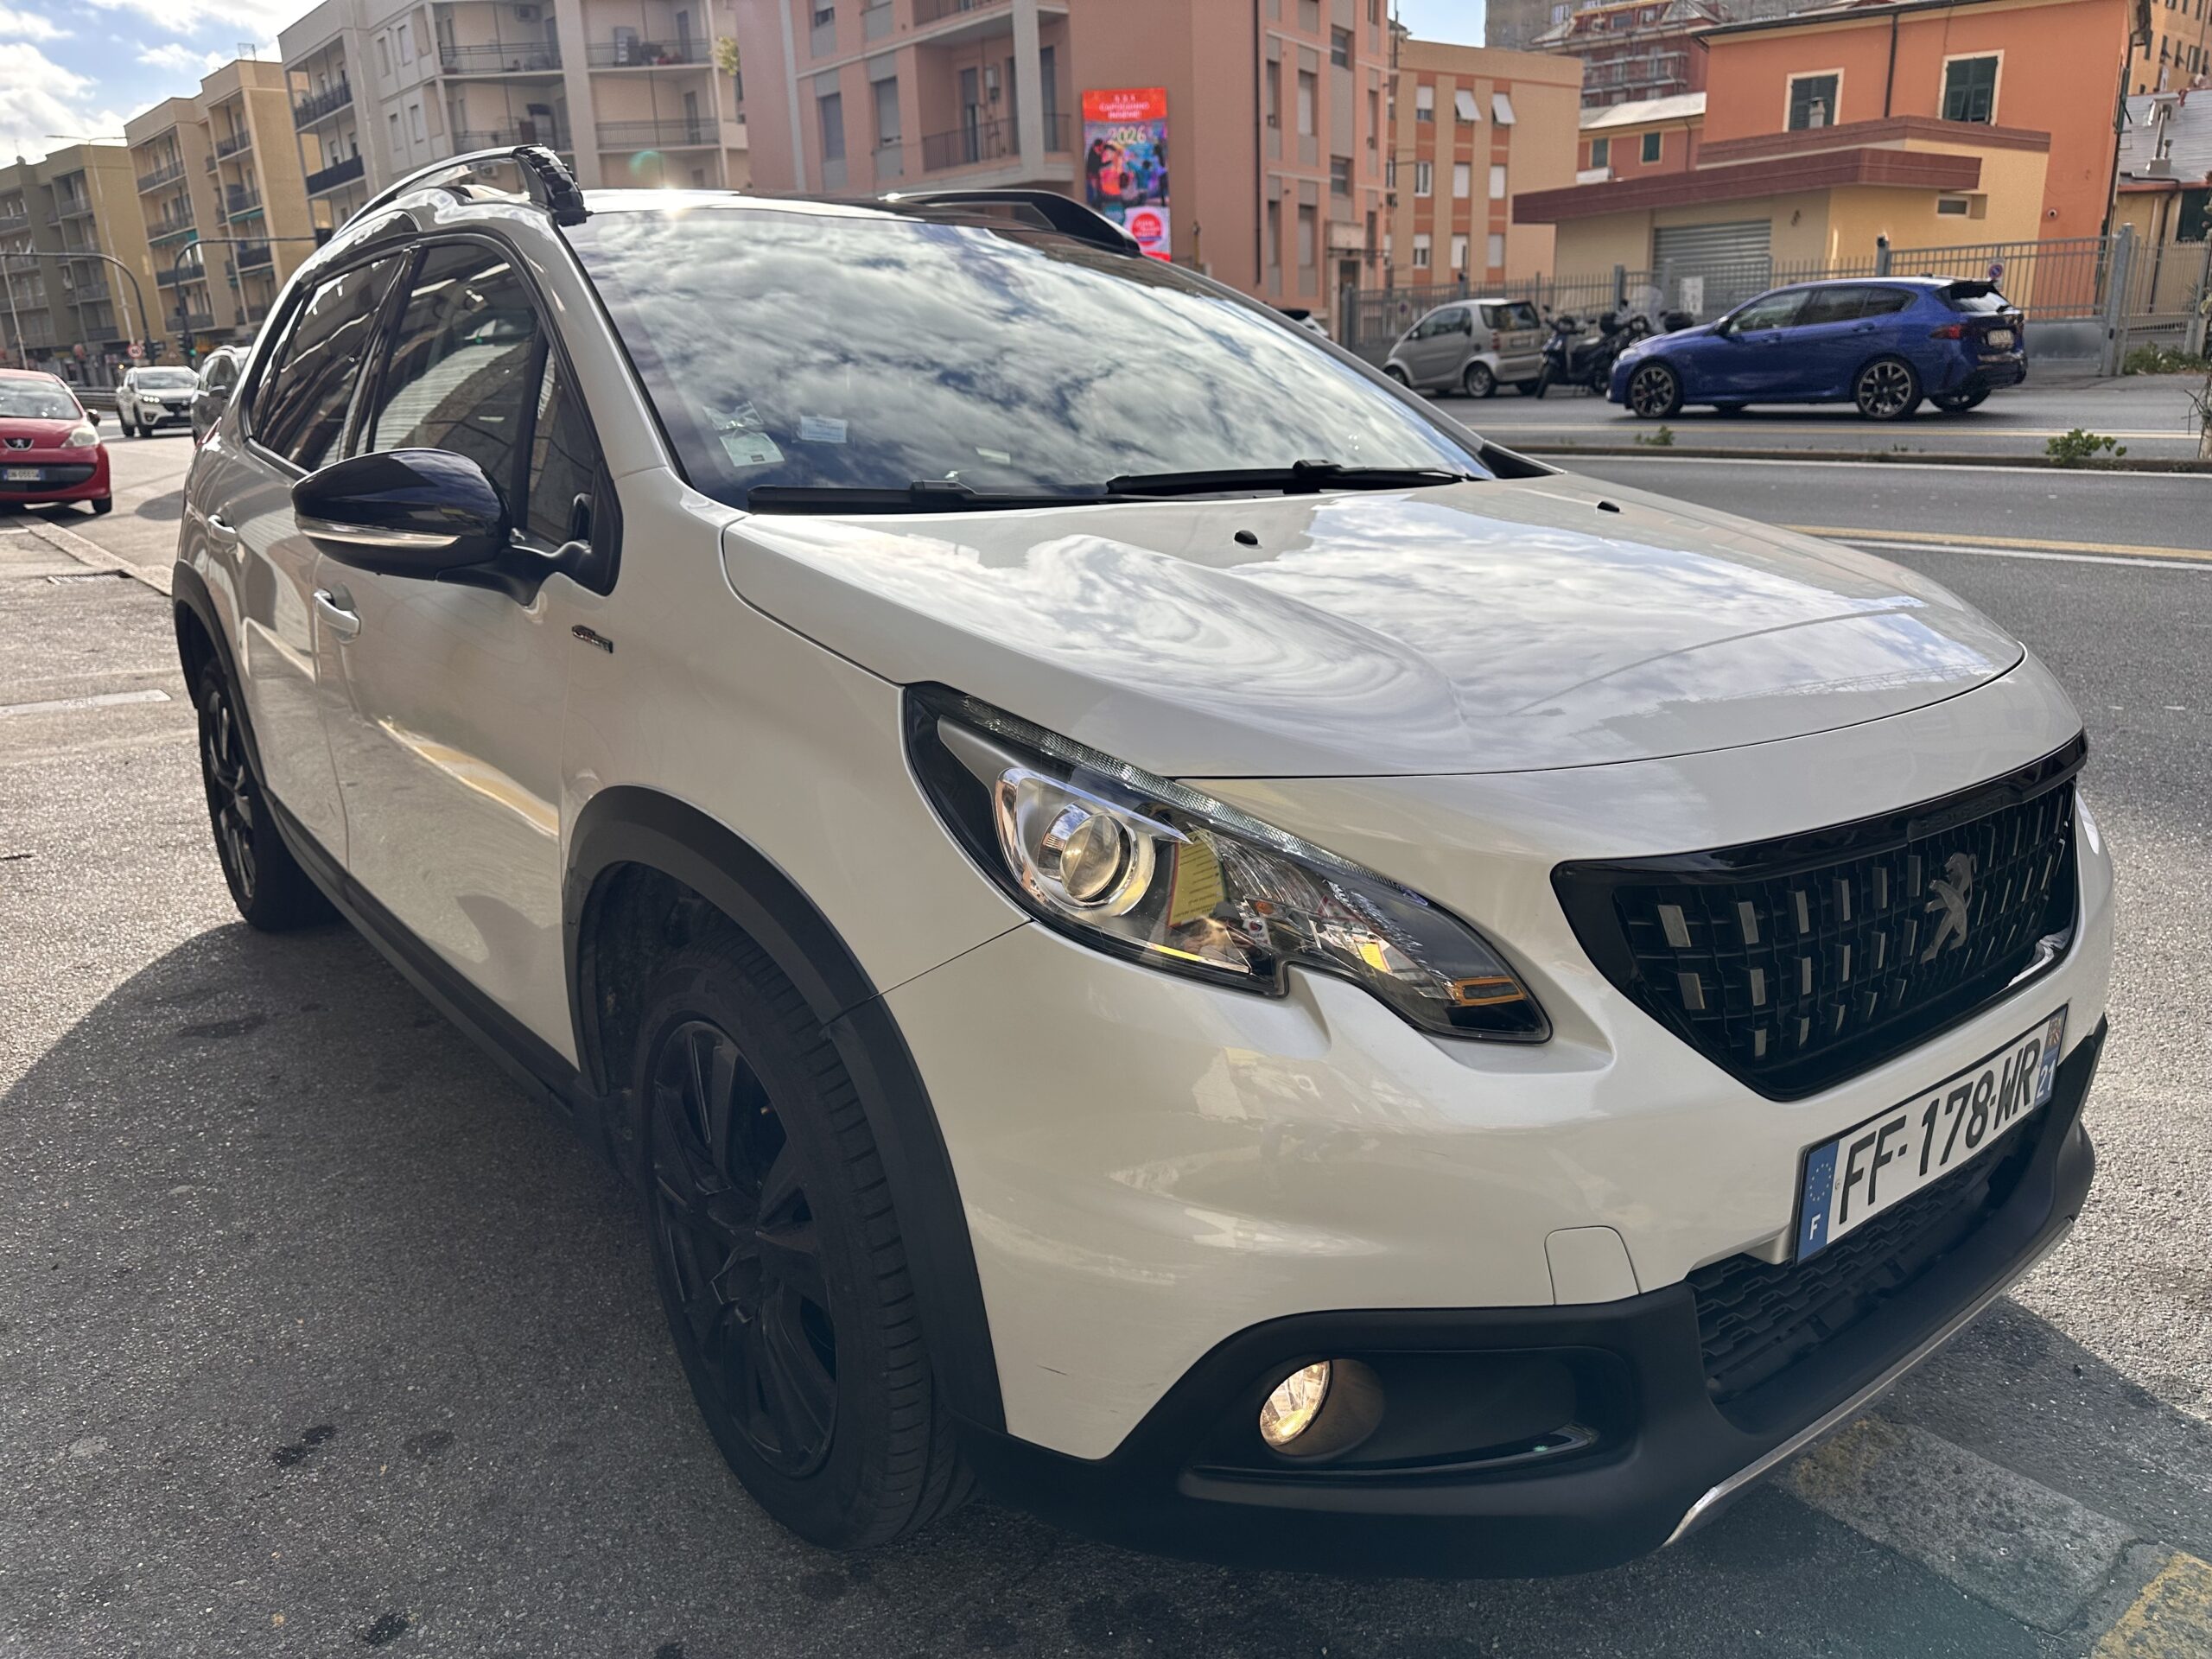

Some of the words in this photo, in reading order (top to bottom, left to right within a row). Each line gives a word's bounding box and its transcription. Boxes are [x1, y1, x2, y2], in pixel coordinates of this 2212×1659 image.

[1107, 124, 1147, 144] 2026
[2037, 1058, 2056, 1099] 21
[1839, 1037, 2041, 1225] FF-178-WR
[1809, 1213, 1821, 1241] F
